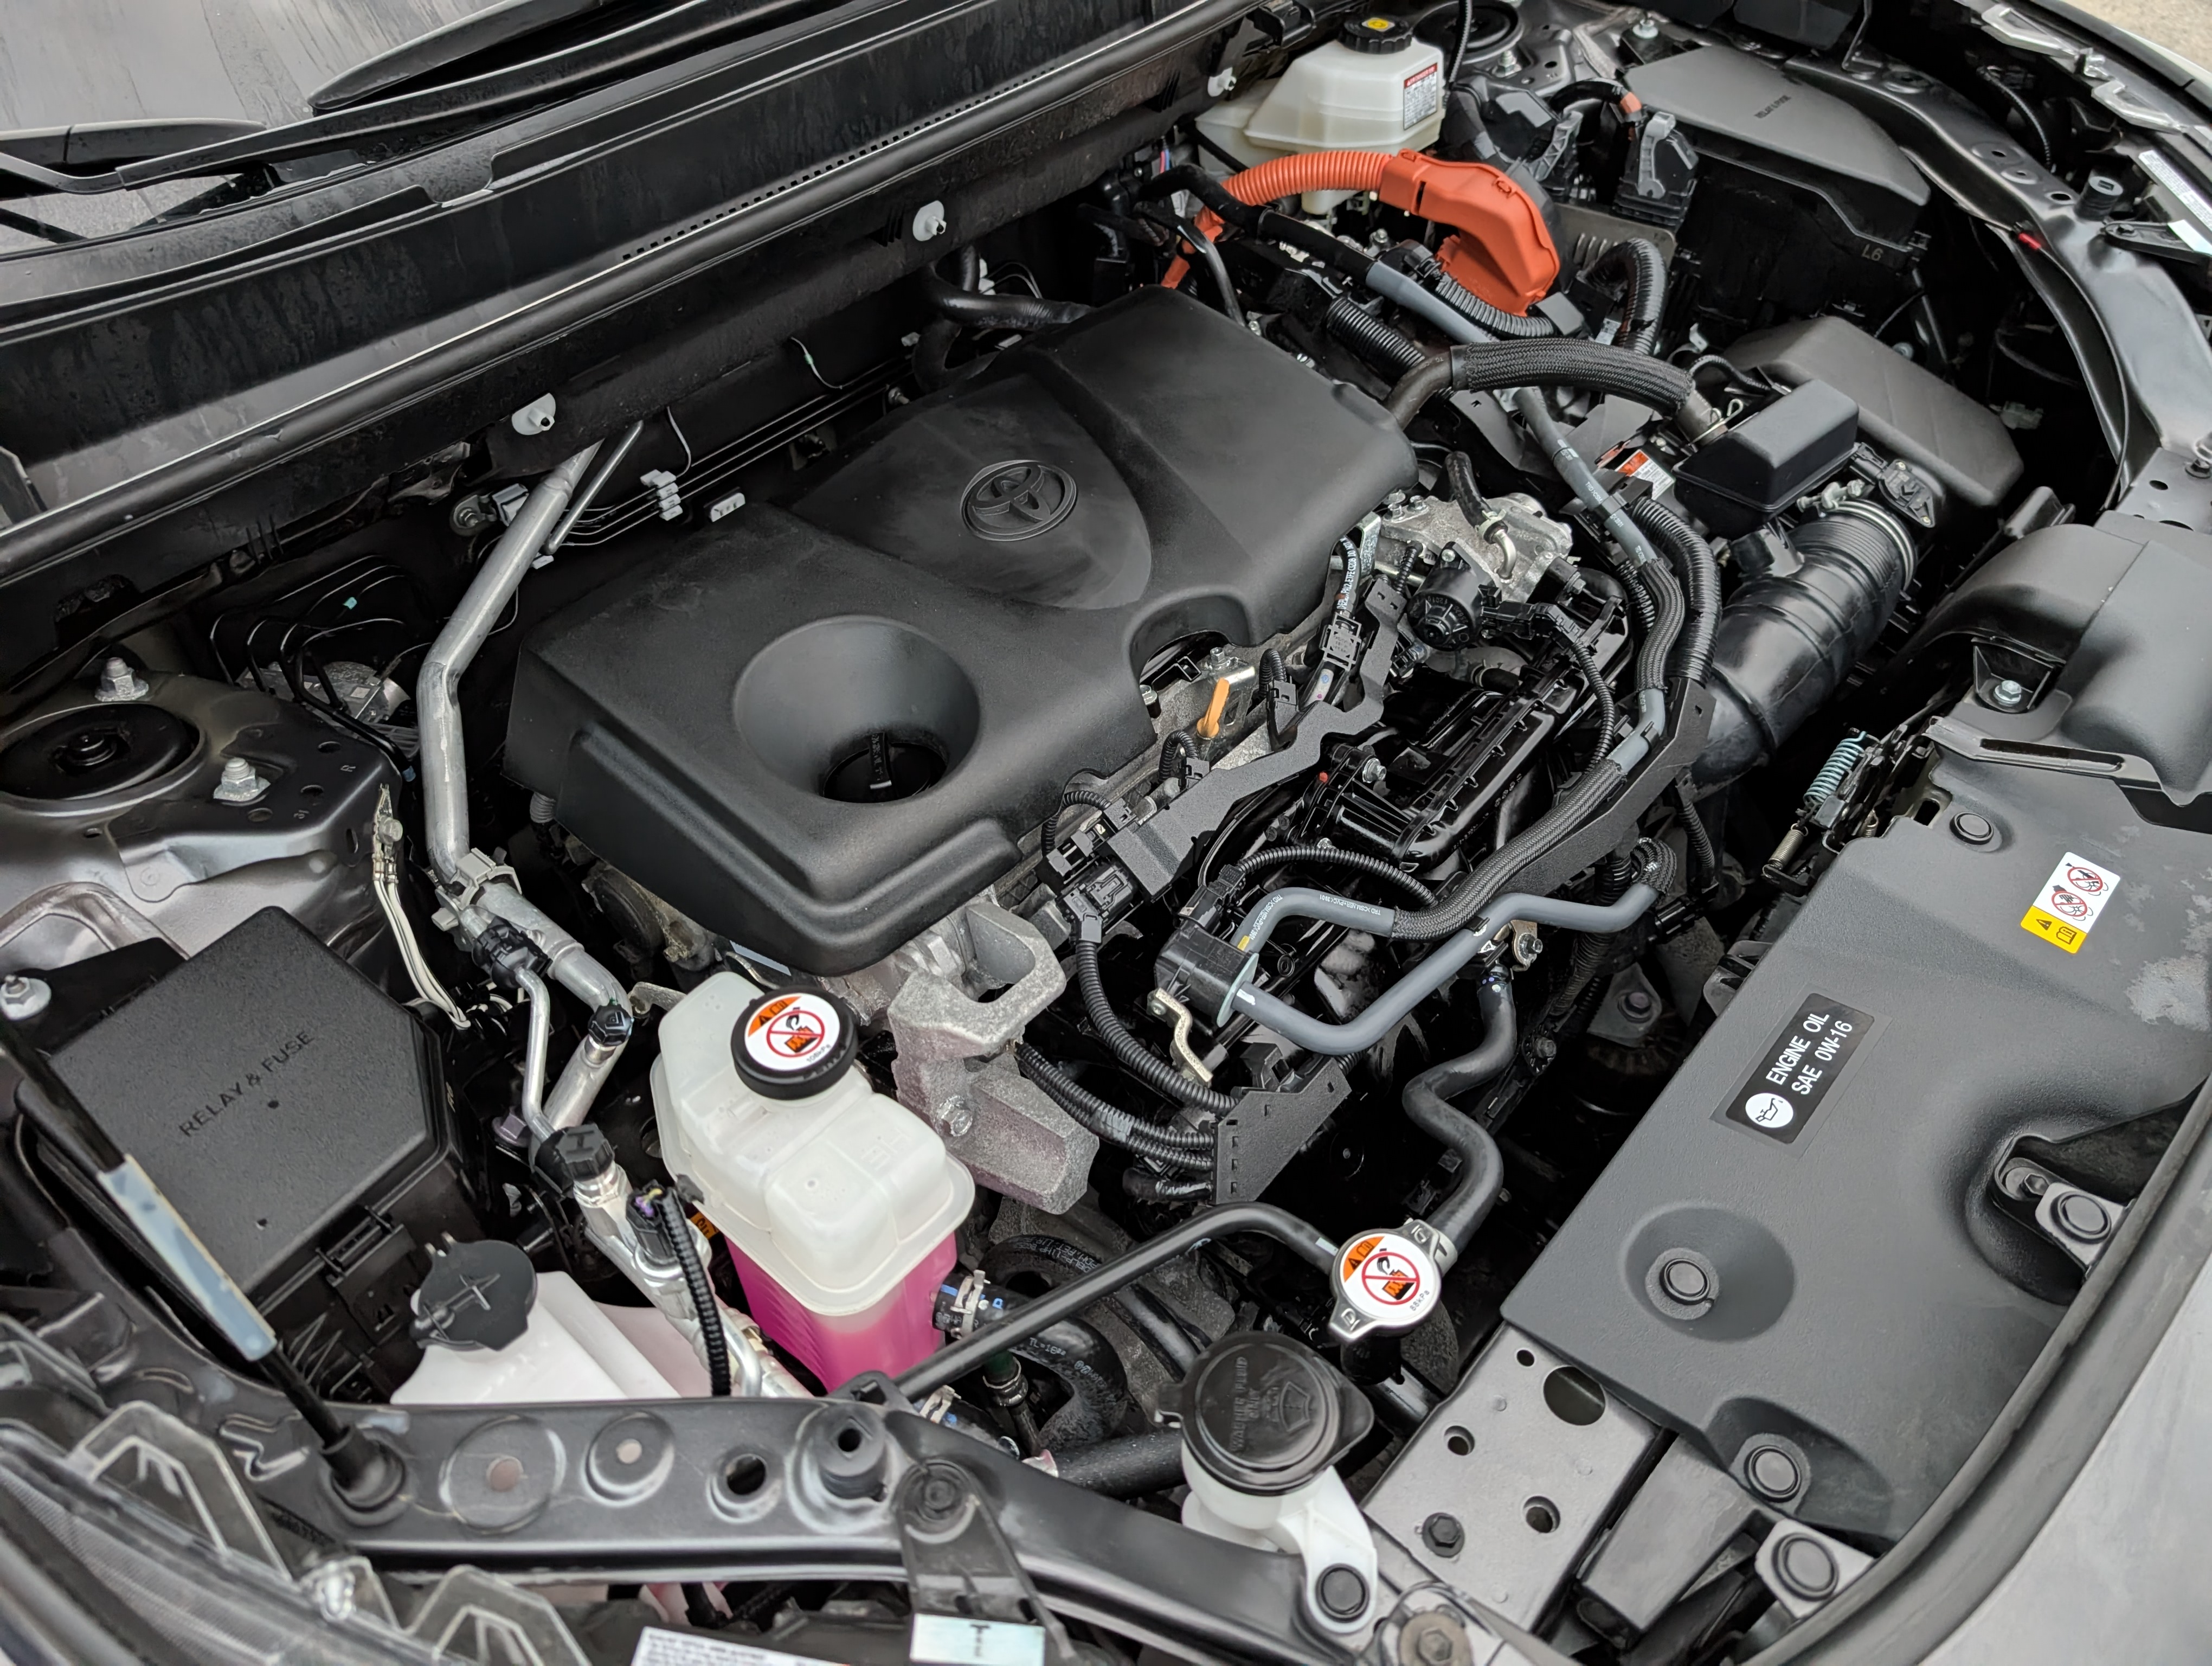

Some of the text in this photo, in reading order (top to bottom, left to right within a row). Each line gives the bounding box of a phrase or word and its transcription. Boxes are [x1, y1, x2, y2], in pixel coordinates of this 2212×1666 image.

[178, 1030, 315, 1137] RELAY & FUSE
[1765, 1013, 1830, 1085] ENGINE OIL
[1791, 1021, 1853, 1095] SAE 0W-16
